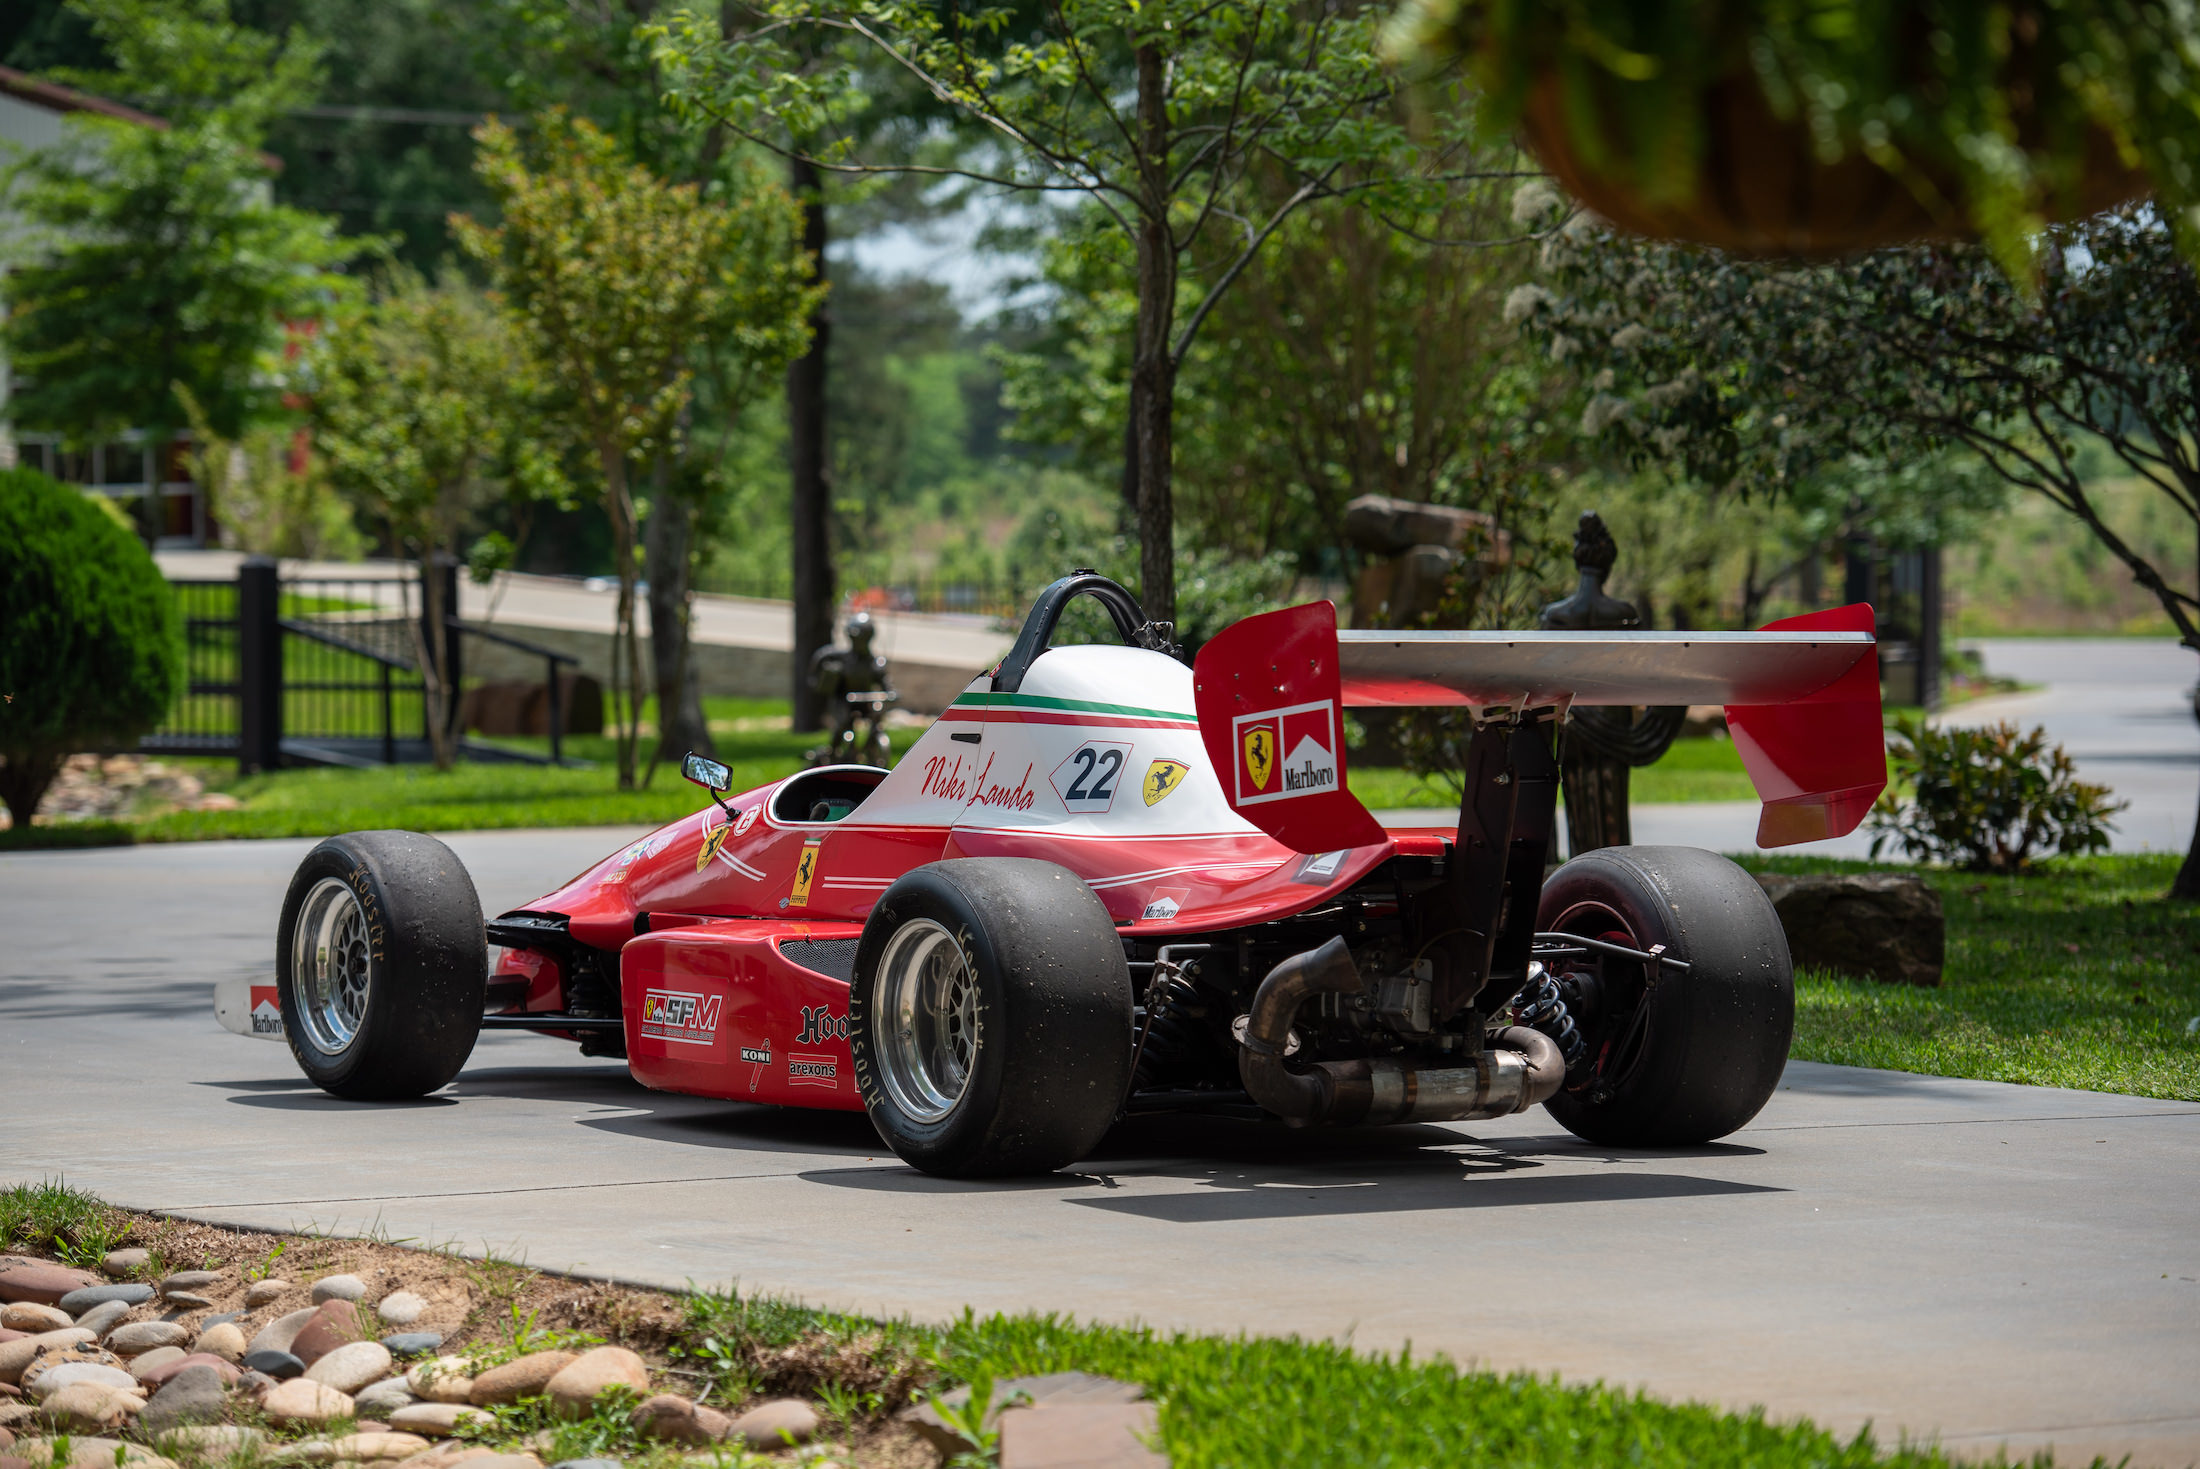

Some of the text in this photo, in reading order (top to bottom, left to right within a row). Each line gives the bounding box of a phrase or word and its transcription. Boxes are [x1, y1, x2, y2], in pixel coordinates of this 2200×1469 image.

[922, 751, 1035, 812] Niki Lauda
[1064, 747, 1124, 800] 22
[1284, 760, 1334, 791] Marlboro
[1143, 905, 1177, 918] Marlboro
[252, 1013, 283, 1034] Marlboro
[664, 995, 723, 1031] SFM
[742, 1050, 770, 1062] KONI
[789, 1062, 836, 1078] arexons
